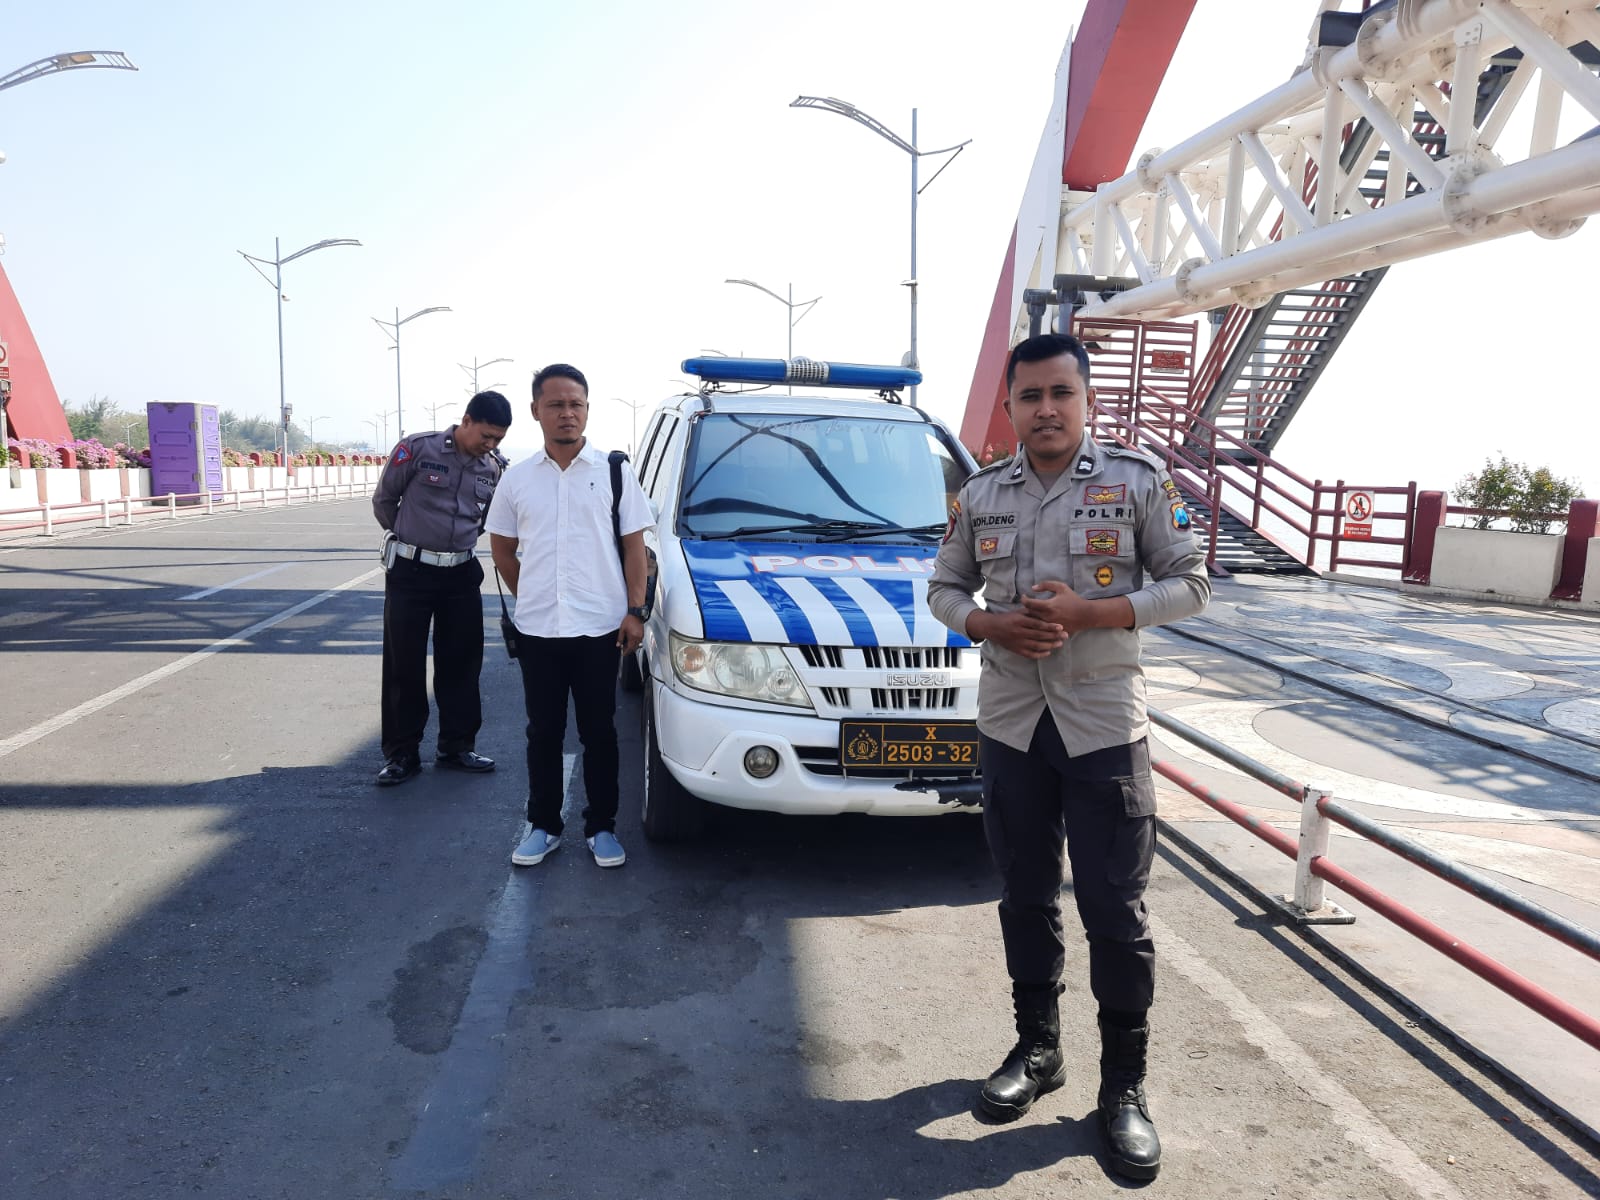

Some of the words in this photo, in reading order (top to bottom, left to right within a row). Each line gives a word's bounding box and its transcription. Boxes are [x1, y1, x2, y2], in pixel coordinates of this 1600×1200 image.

[1074, 508, 1132, 518] POLRI
[752, 555, 937, 573] POLI
[887, 673, 947, 687] ISUZU
[925, 727, 937, 740] X
